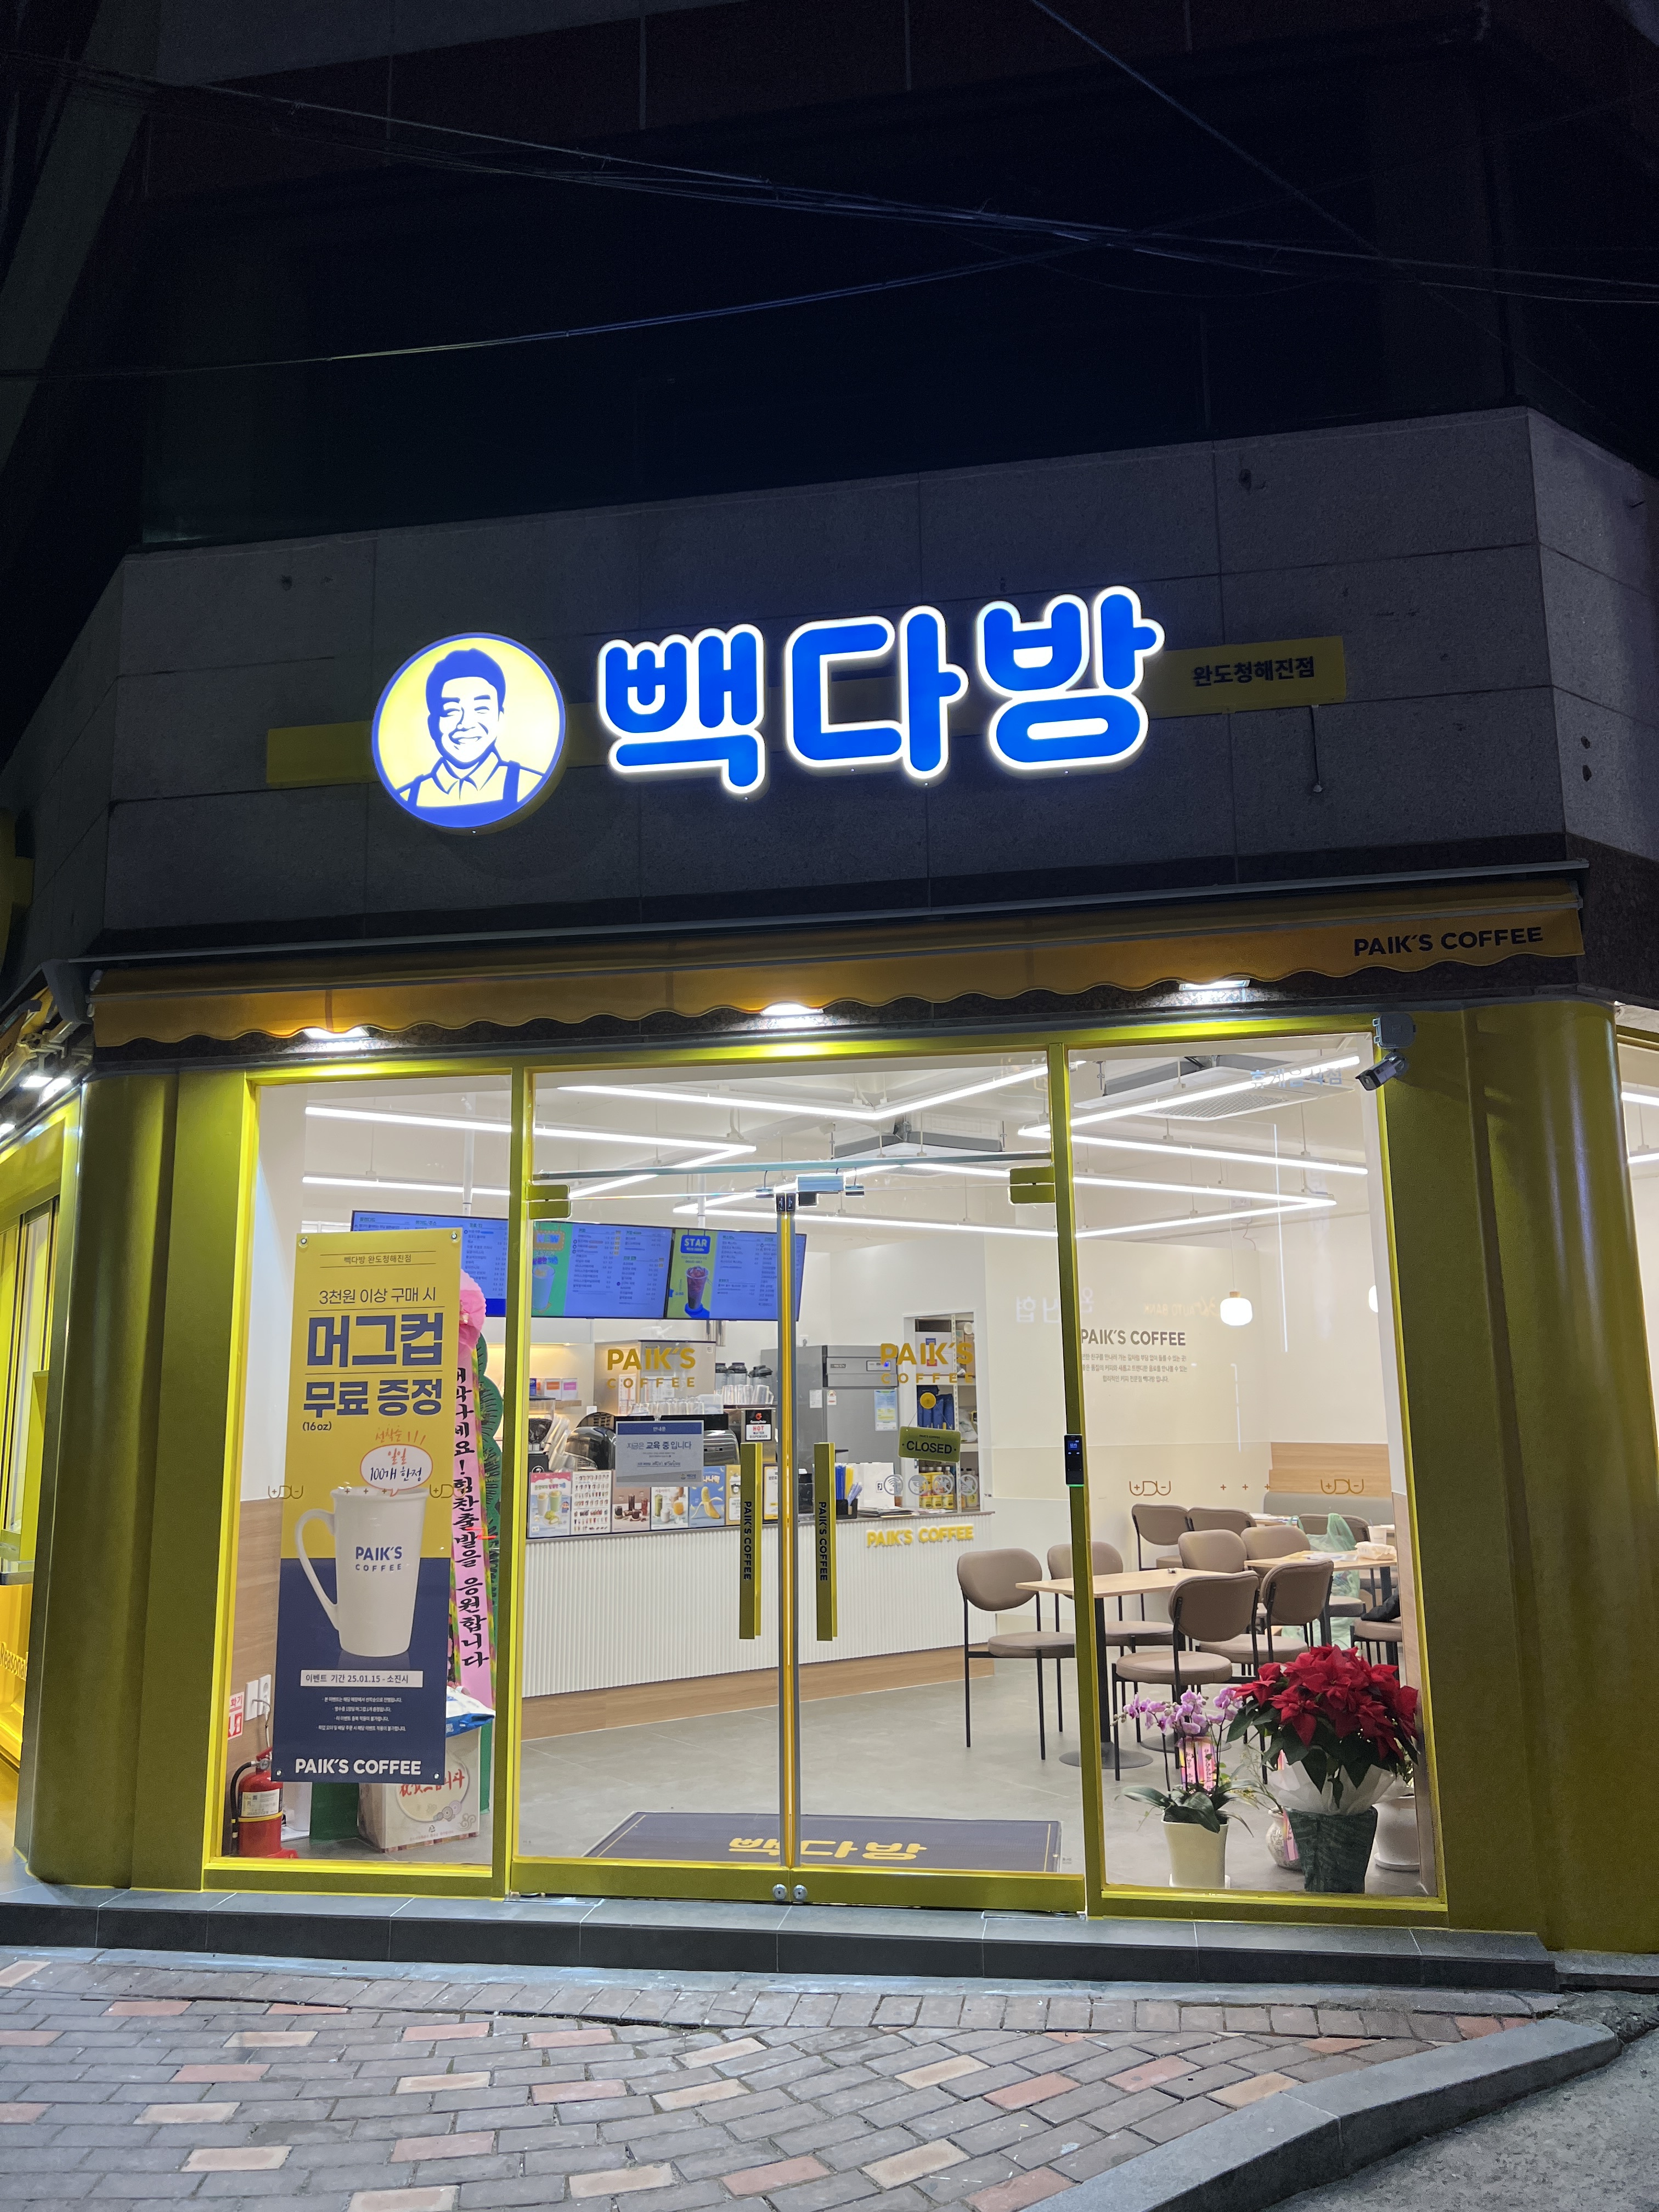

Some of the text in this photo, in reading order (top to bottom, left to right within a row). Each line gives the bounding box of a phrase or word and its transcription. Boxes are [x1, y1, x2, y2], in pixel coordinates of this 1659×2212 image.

[1193, 656, 1315, 686] 완도청해진점
[599, 586, 1164, 793] 빽다방
[1354, 927, 1544, 957] PAIK'S COFFEE
[537, 1233, 561, 1244] NEW
[684, 1238, 707, 1247] STAR
[368, 1254, 411, 1264] 완도청해진점
[319, 1287, 436, 1305] 3천원 이상 구매 시
[307, 1312, 443, 1367] 머그컵
[1081, 1329, 1186, 1346] PAIK'S COFFEE
[607, 1347, 696, 1370] PAIK'S
[880, 1342, 974, 1365] PAIK'S
[607, 1376, 695, 1389] COFFEE
[881, 1373, 973, 1384] COFFEE
[303, 1379, 442, 1418] 무료 증정
[302, 1422, 332, 1431] (16oz)
[375, 1427, 402, 1443] 선착순
[646, 1441, 660, 1449] 교육
[662, 1441, 669, 1449] 중
[670, 1441, 692, 1449] 입니다
[906, 1440, 952, 1454] CLOSED
[387, 1448, 407, 1465] 일일
[370, 1466, 422, 1482] 100개 한정
[743, 1501, 752, 1581] PAIK'S COFFEE
[819, 1501, 827, 1581] PAIK'S COFFEE
[866, 1524, 974, 1547] PAIK'S COFFEE
[355, 1546, 403, 1561] PAIK'S
[355, 1563, 402, 1572] COFFEE
[456, 1577, 489, 1668] 응원합니다
[306, 1674, 327, 1683] 이벤트
[331, 1674, 345, 1683] 기간
[387, 1674, 409, 1684] 소진시
[230, 1695, 243, 1707] 화기
[295, 1758, 421, 1775] PAIK'S COFFEE
[729, 1837, 927, 1860] 빽다방
